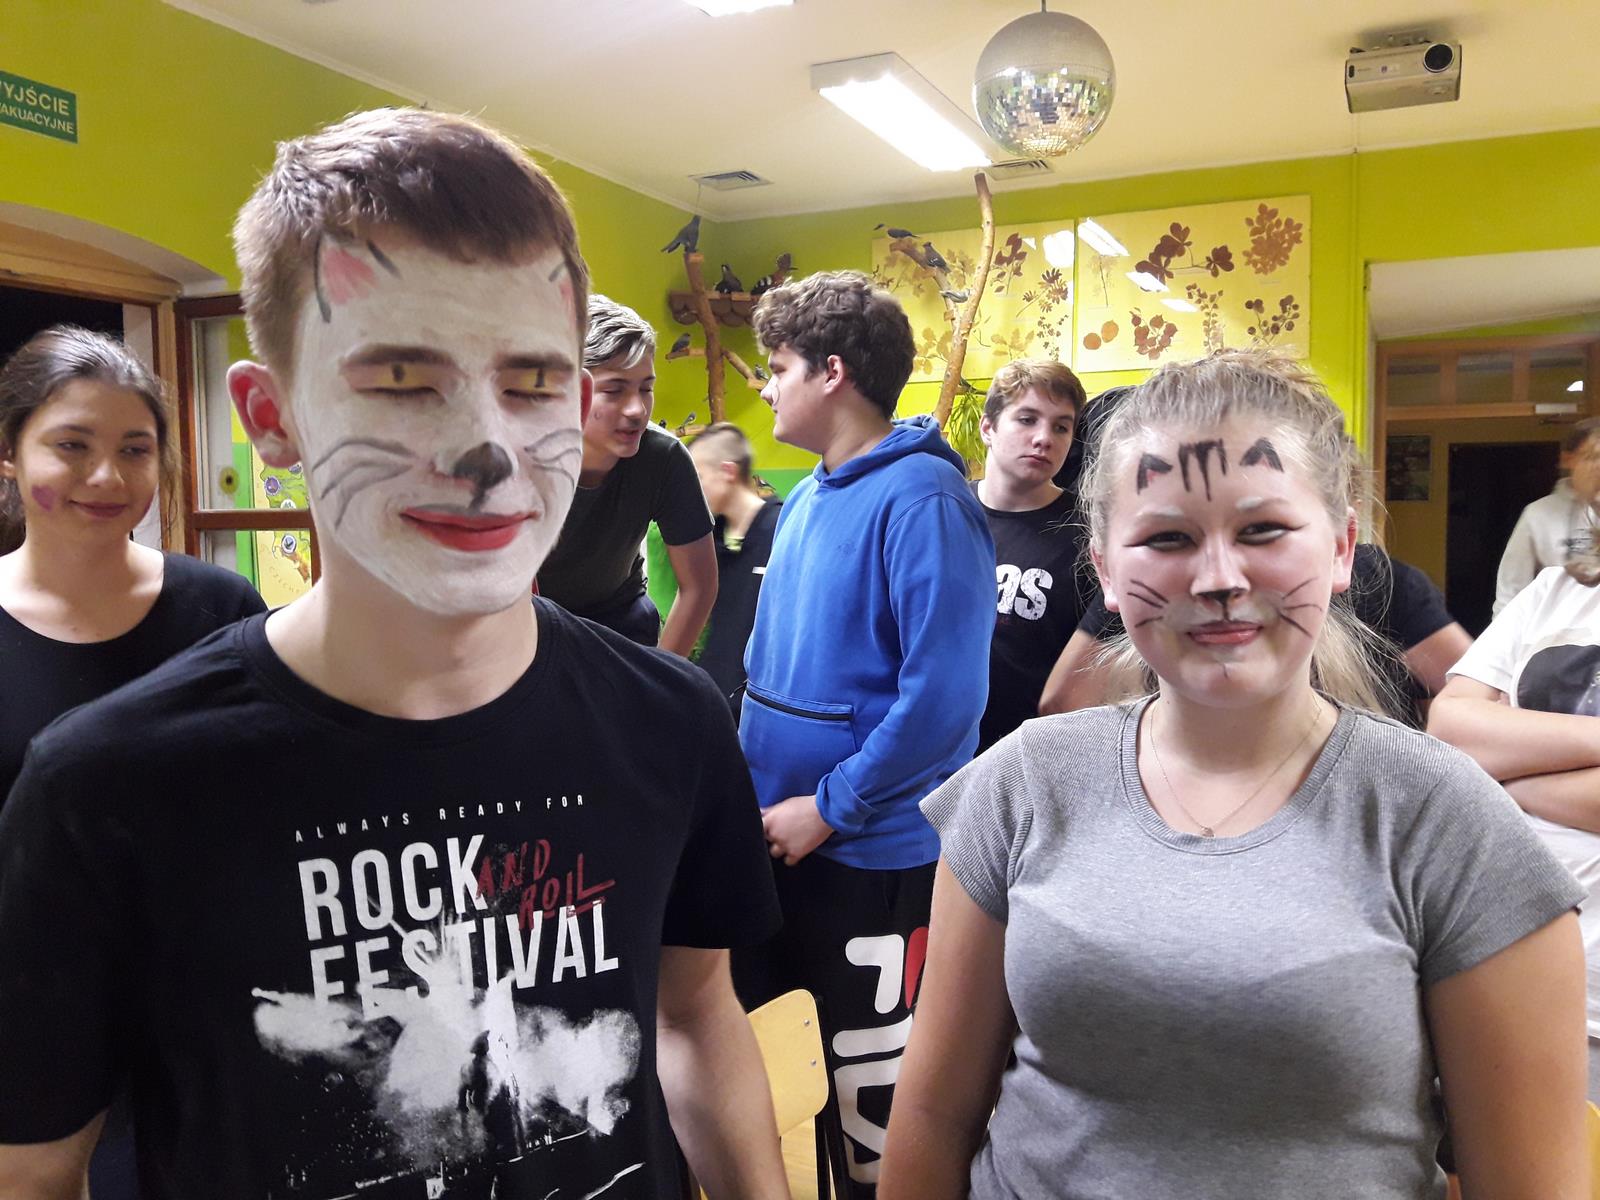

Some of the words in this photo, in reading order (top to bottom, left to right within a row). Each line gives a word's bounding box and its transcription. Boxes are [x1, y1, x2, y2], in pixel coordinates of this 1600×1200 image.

[0, 81, 70, 116] YJŚCIE
[0, 103, 75, 134] AKUACYJNE
[295, 813, 409, 843] ALWAYS
[439, 800, 521, 821] READY
[546, 794, 583, 809] FOR
[298, 834, 489, 941] ROCK
[475, 839, 551, 900] AND
[310, 900, 619, 1021] FESTIVAL
